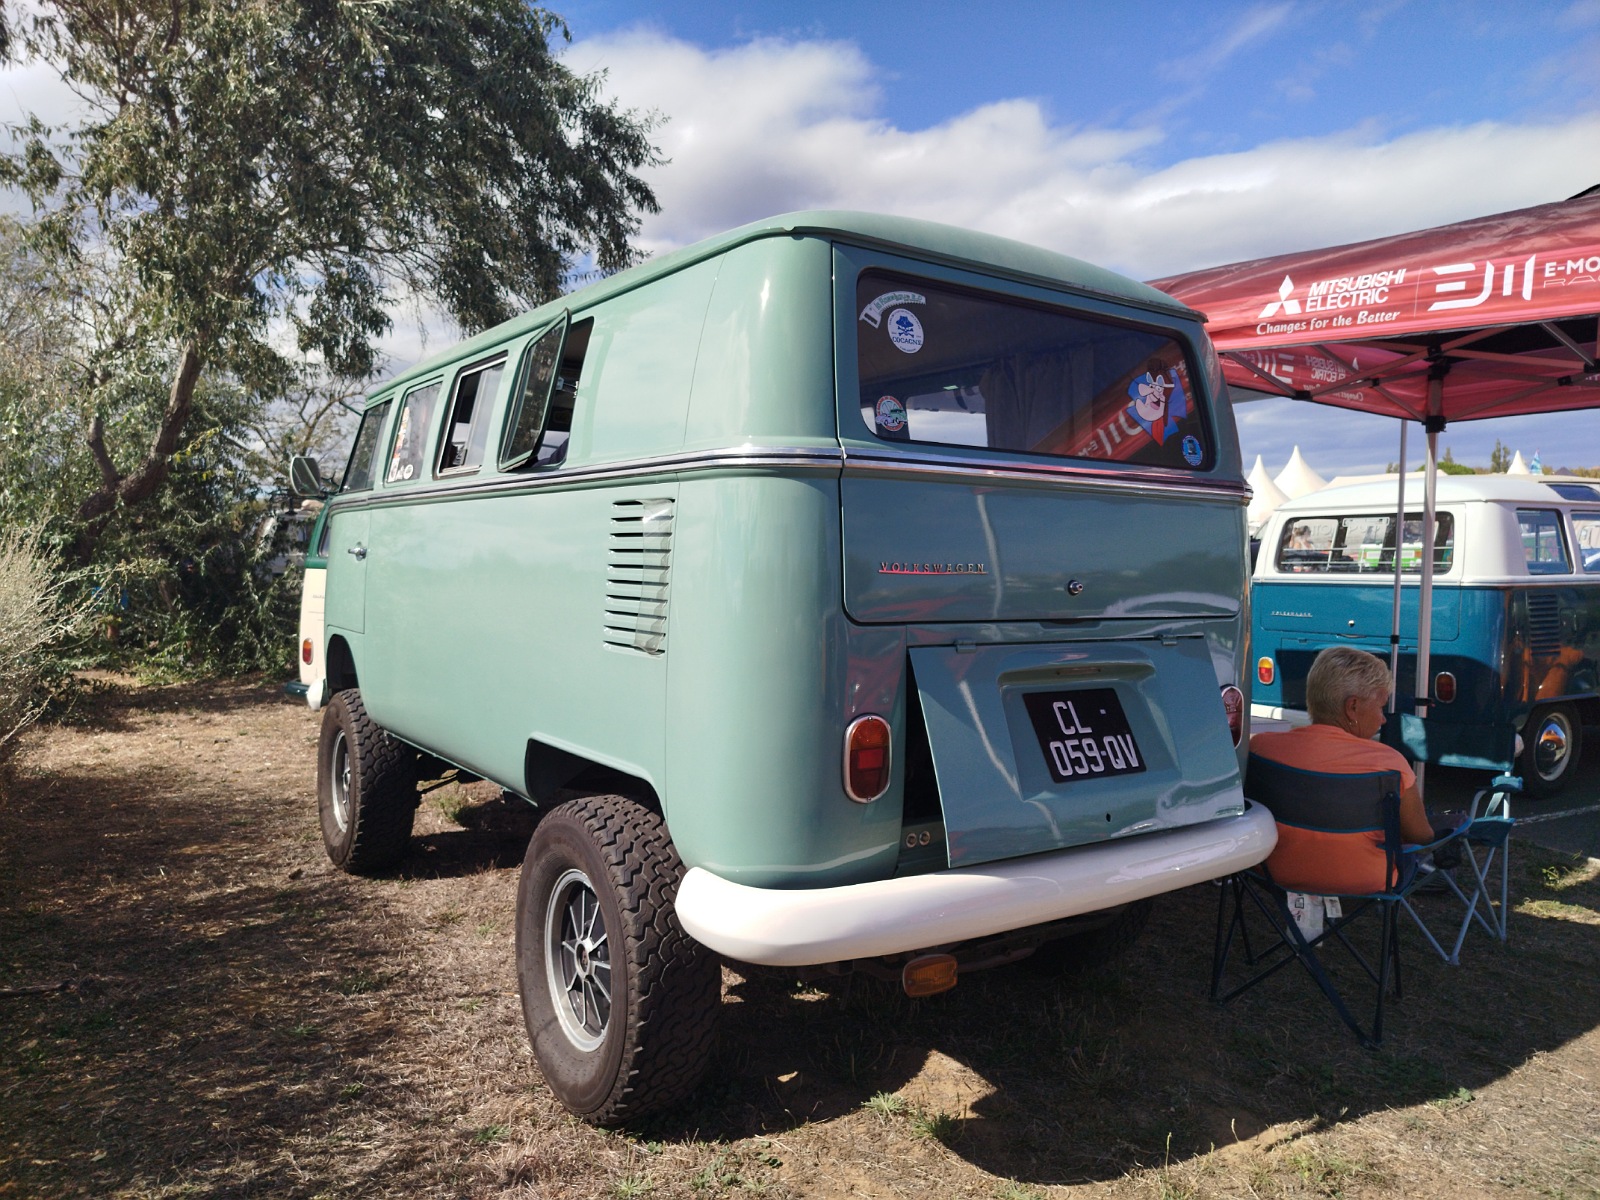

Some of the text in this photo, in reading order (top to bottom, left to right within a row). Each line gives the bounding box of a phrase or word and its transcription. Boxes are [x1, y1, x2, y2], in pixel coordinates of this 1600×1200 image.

[1308, 268, 1407, 297] MITSUBISHI
[1305, 287, 1389, 313] ELECTRIC
[1256, 310, 1400, 335] Changes for the Better
[880, 561, 985, 574] VOLKSWAGEN
[1052, 700, 1092, 735] CL
